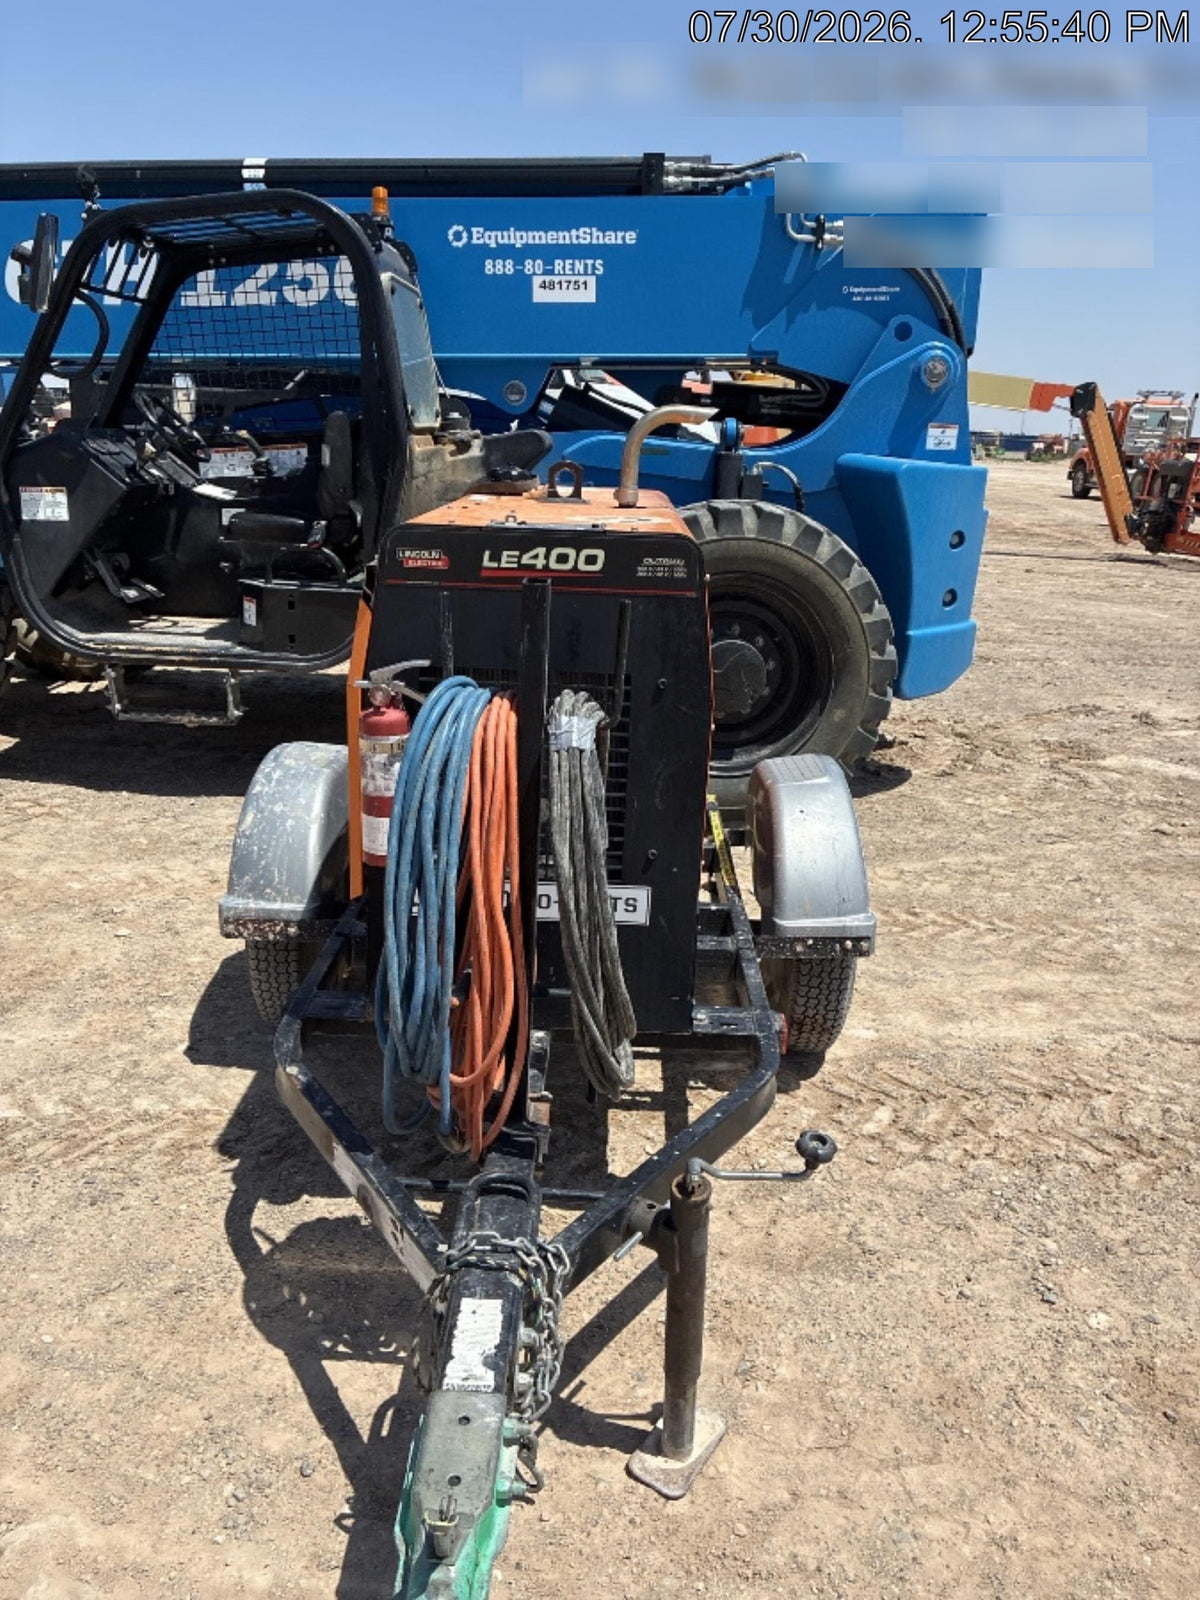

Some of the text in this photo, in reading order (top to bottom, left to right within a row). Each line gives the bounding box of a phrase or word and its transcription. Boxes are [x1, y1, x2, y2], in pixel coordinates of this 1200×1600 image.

[470, 226, 637, 248] EquipmentShare
[484, 258, 604, 275] 888-80-RENTS
[538, 279, 589, 291] 481751
[399, 550, 441, 559] LINCOLN
[482, 546, 606, 572] LE400
